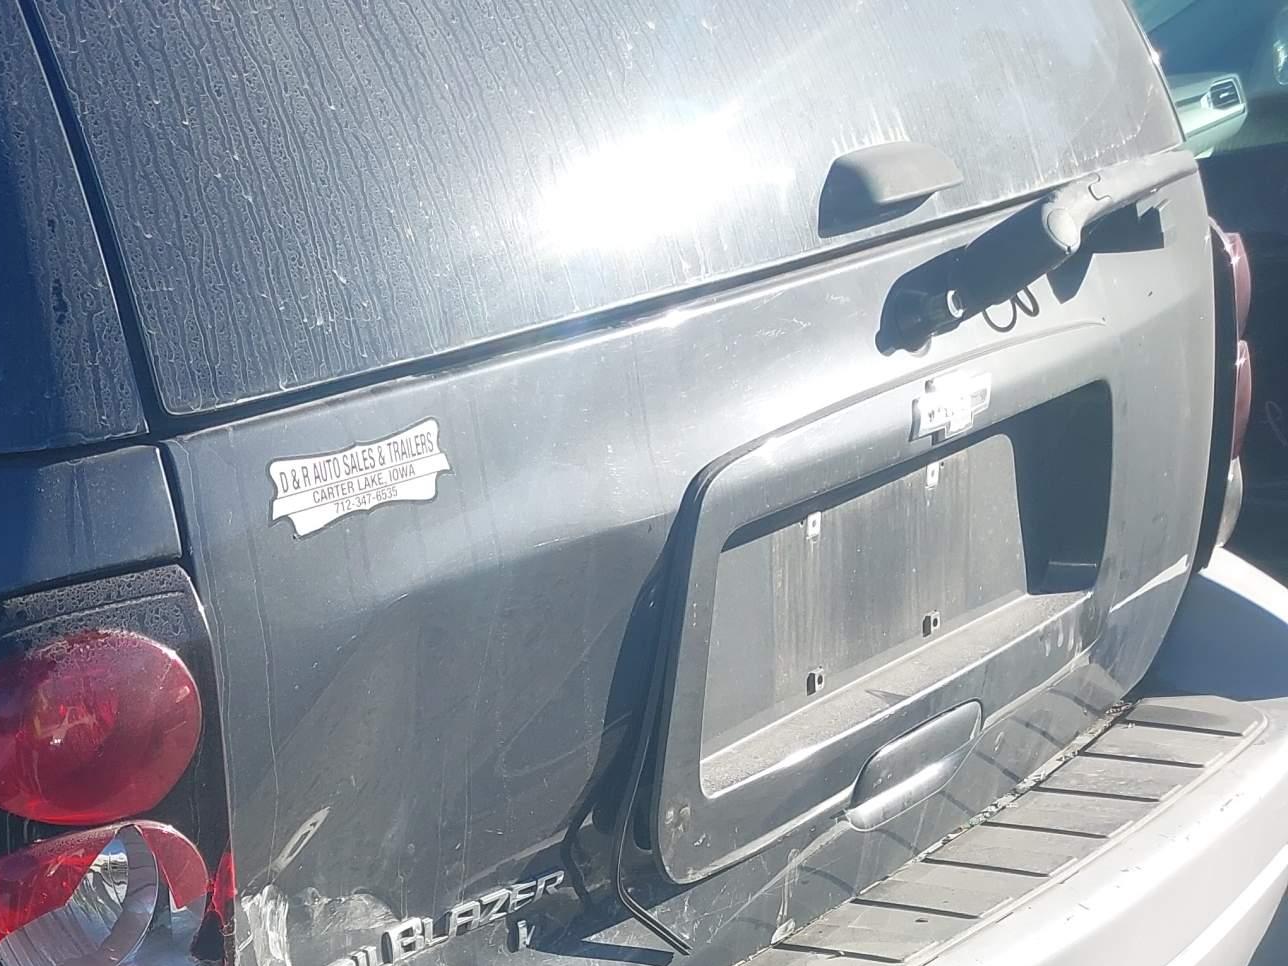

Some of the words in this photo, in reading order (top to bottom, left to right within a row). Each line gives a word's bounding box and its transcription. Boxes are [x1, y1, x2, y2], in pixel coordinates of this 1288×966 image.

[279, 471, 289, 493] D
[292, 469, 302, 489] &
[301, 465, 311, 487] R
[314, 456, 341, 484] AUTO
[343, 447, 376, 476] SALES
[377, 445, 386, 466] &
[386, 431, 434, 464] TRAILERS
[312, 482, 355, 503] CARTER
[388, 464, 416, 483] IOWA
[334, 486, 398, 514] 712-347-6535
